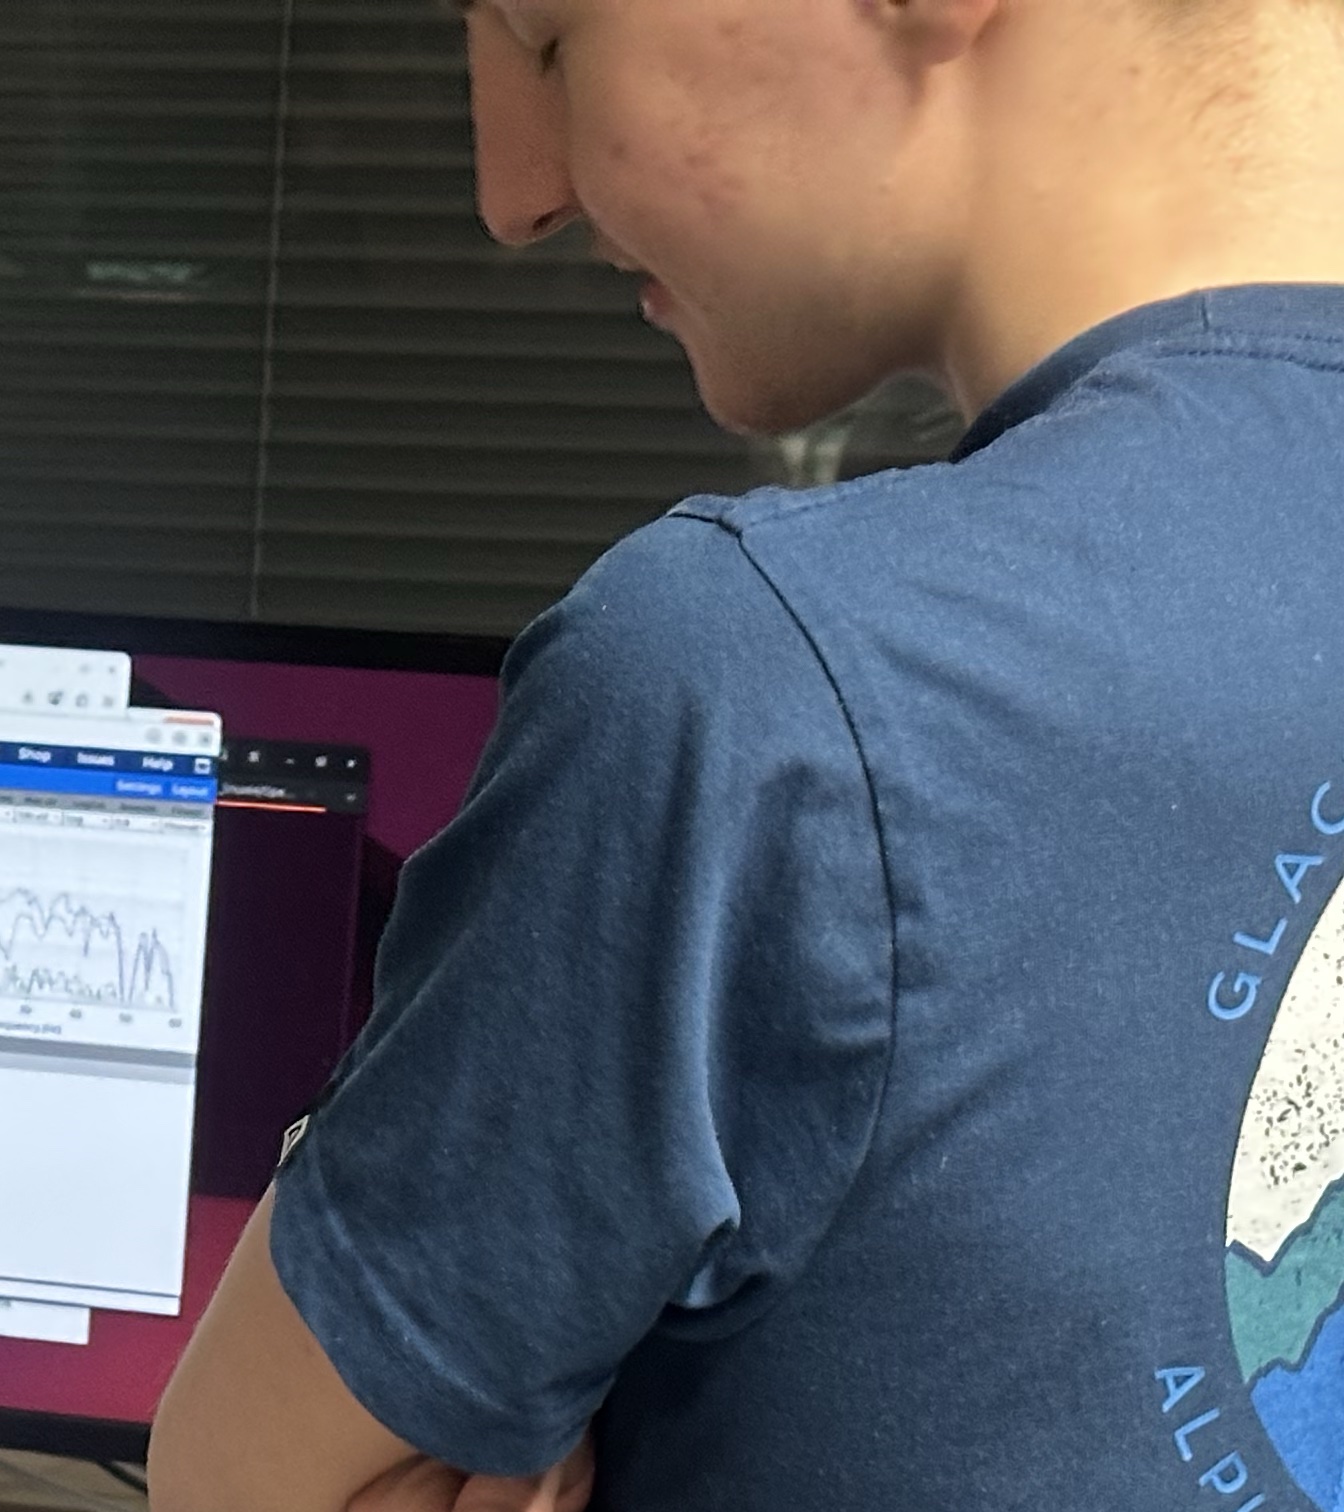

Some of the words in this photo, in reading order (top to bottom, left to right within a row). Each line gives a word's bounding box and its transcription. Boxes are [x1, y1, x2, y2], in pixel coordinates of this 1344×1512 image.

[18, 746, 52, 763] Shop
[77, 752, 115, 766] Issues
[142, 757, 174, 772] Help
